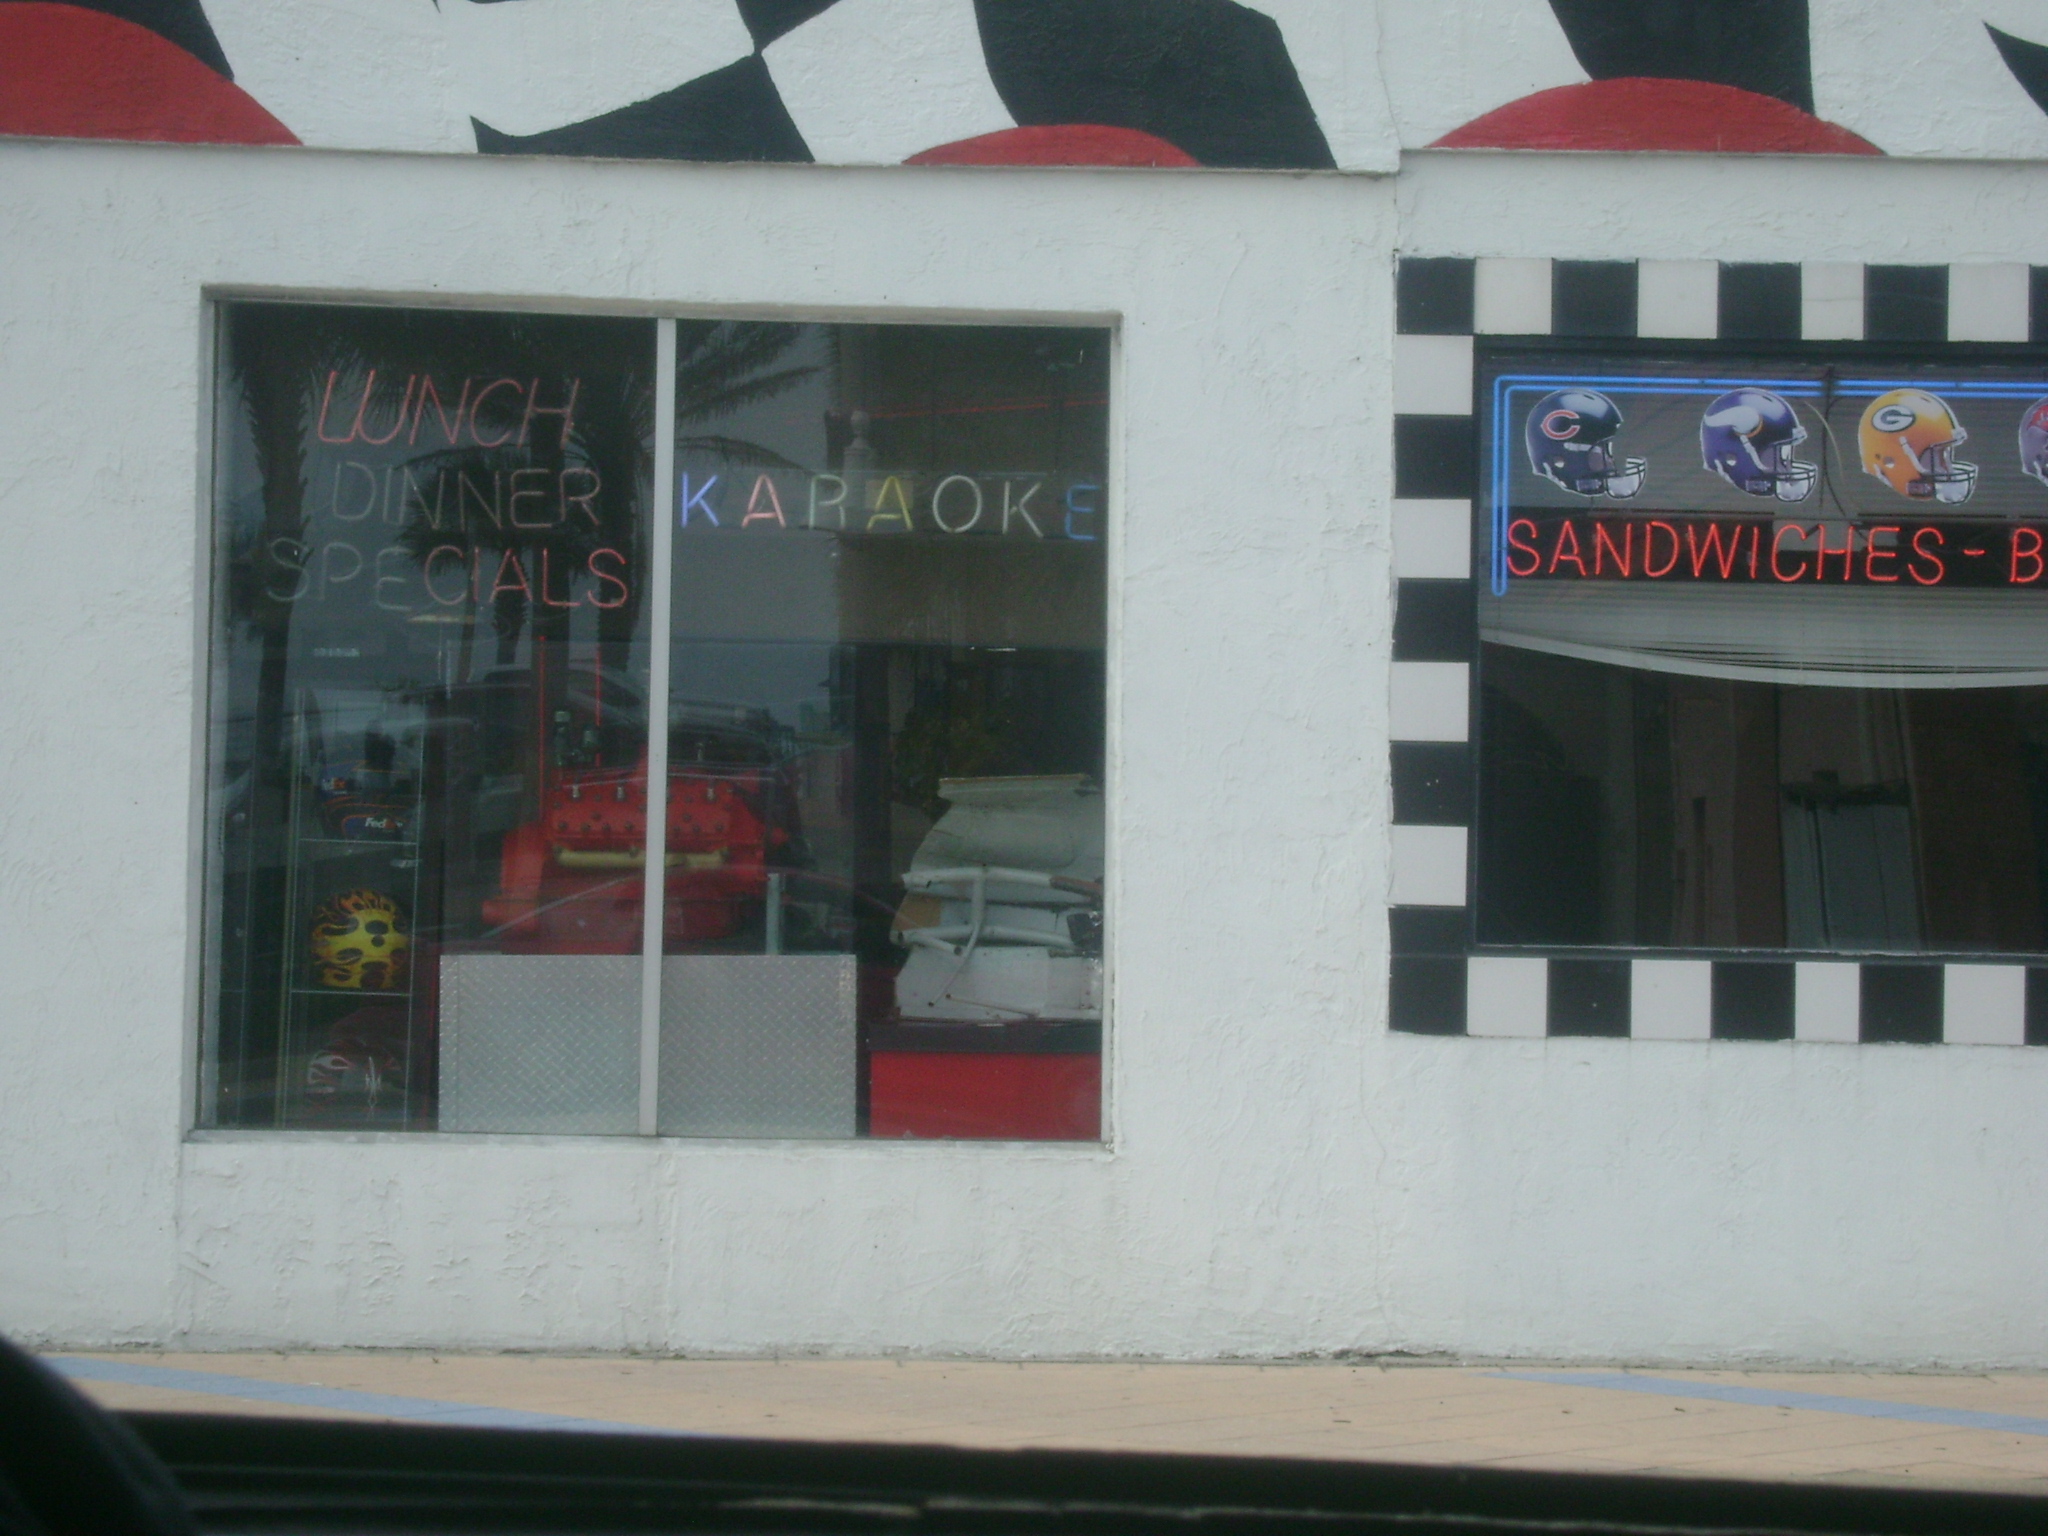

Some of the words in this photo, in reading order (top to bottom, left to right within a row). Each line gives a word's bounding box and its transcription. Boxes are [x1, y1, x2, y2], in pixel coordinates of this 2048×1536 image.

[318, 369, 580, 448] LUNCH
[331, 461, 602, 530] DINNER
[680, 471, 1100, 541] KARAOKE
[266, 537, 629, 609] SPECIALS
[1506, 518, 1945, 586] SANDWICHES
